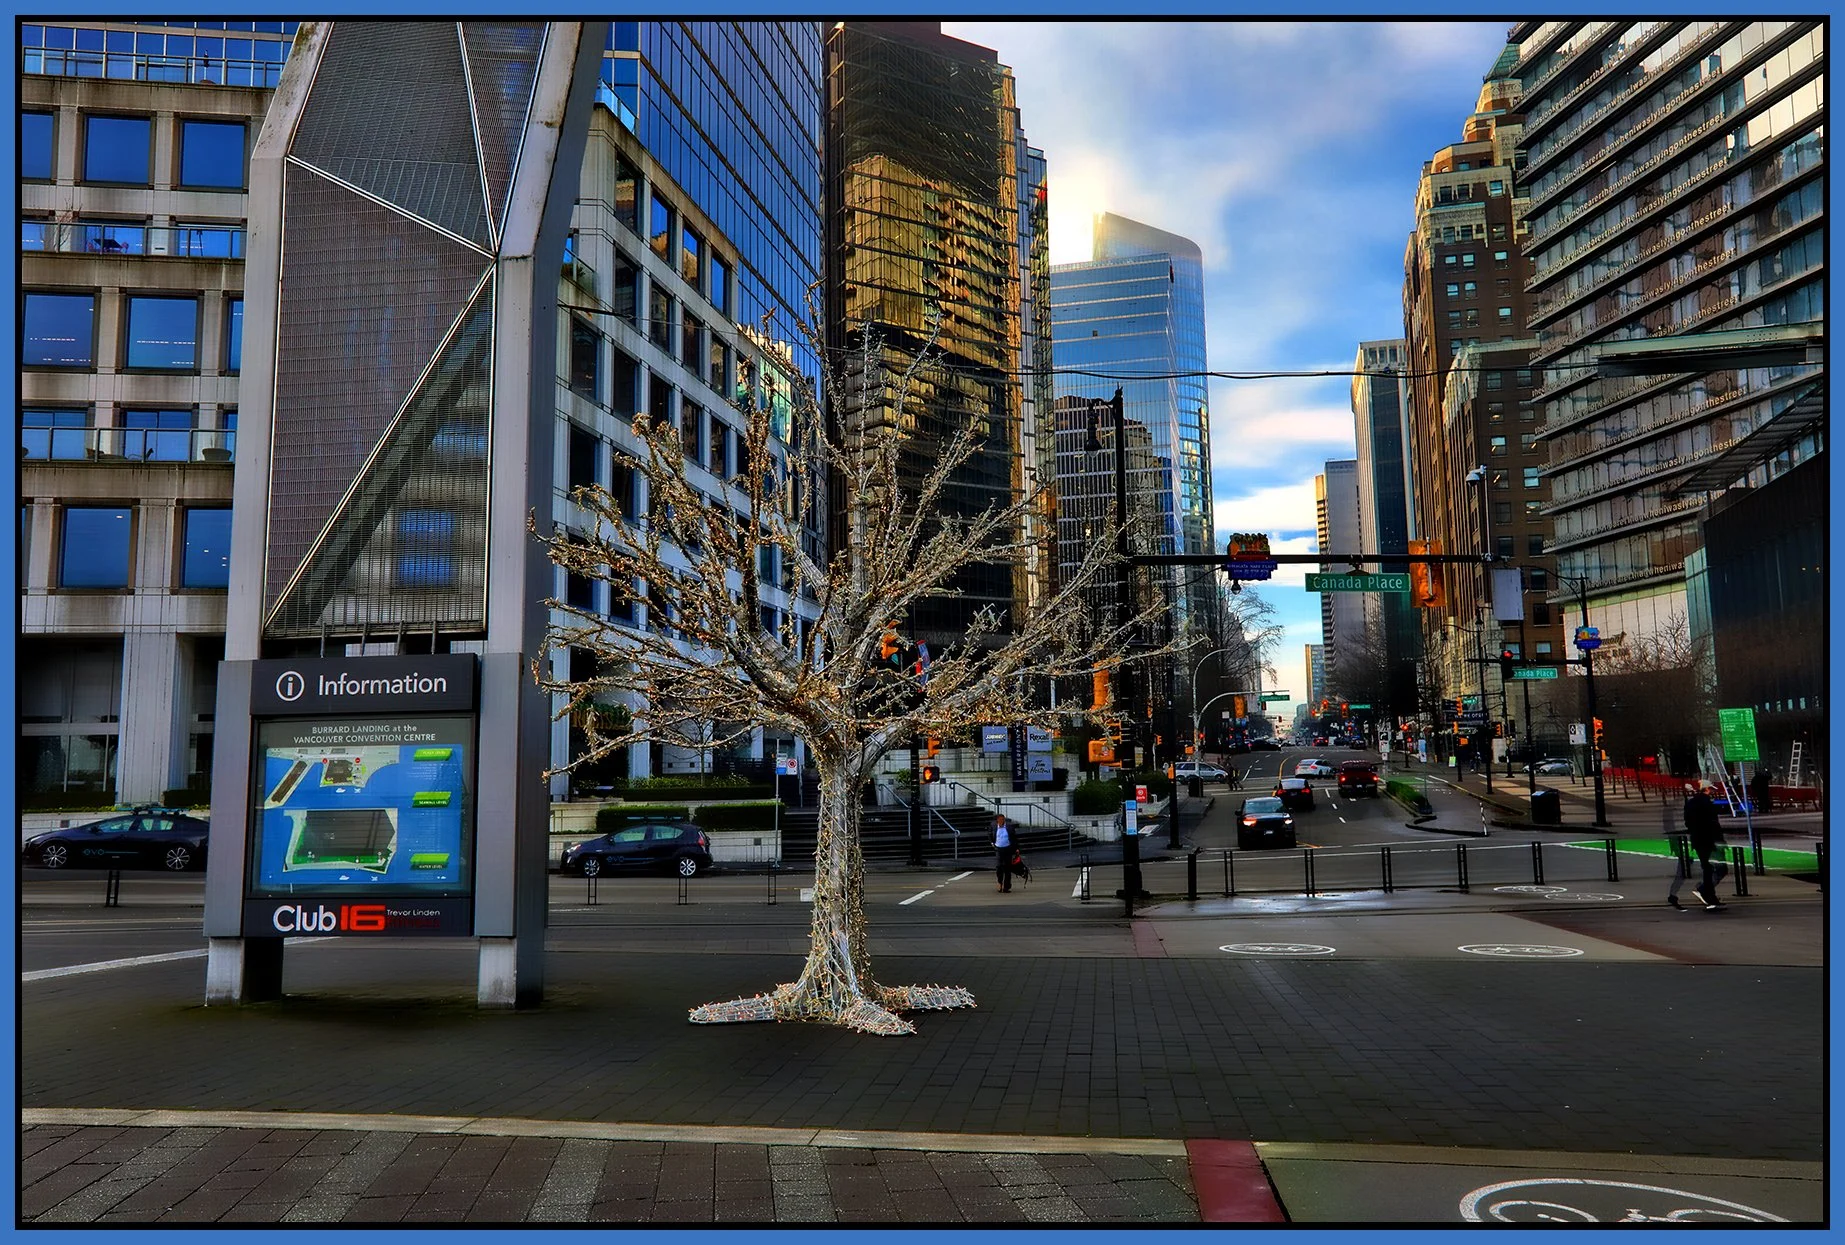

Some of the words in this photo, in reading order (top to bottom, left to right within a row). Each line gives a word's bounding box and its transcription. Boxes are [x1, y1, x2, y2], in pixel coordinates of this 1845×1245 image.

[1313, 575, 1362, 589] Canada
[1368, 575, 1403, 589] Place
[318, 672, 448, 696] Information
[312, 725, 350, 734] BURRARD
[352, 724, 390, 733] LANDING
[403, 724, 417, 732] the
[293, 735, 344, 744] VANCOUVER
[345, 734, 402, 743] CONVENTION
[403, 733, 436, 742] CENTRE
[1030, 766, 1051, 774] Hortons
[82, 848, 105, 856] evo
[606, 855, 625, 863] evo
[412, 908, 441, 916] Linden
[272, 904, 337, 932] Club
[340, 904, 386, 931] 16
